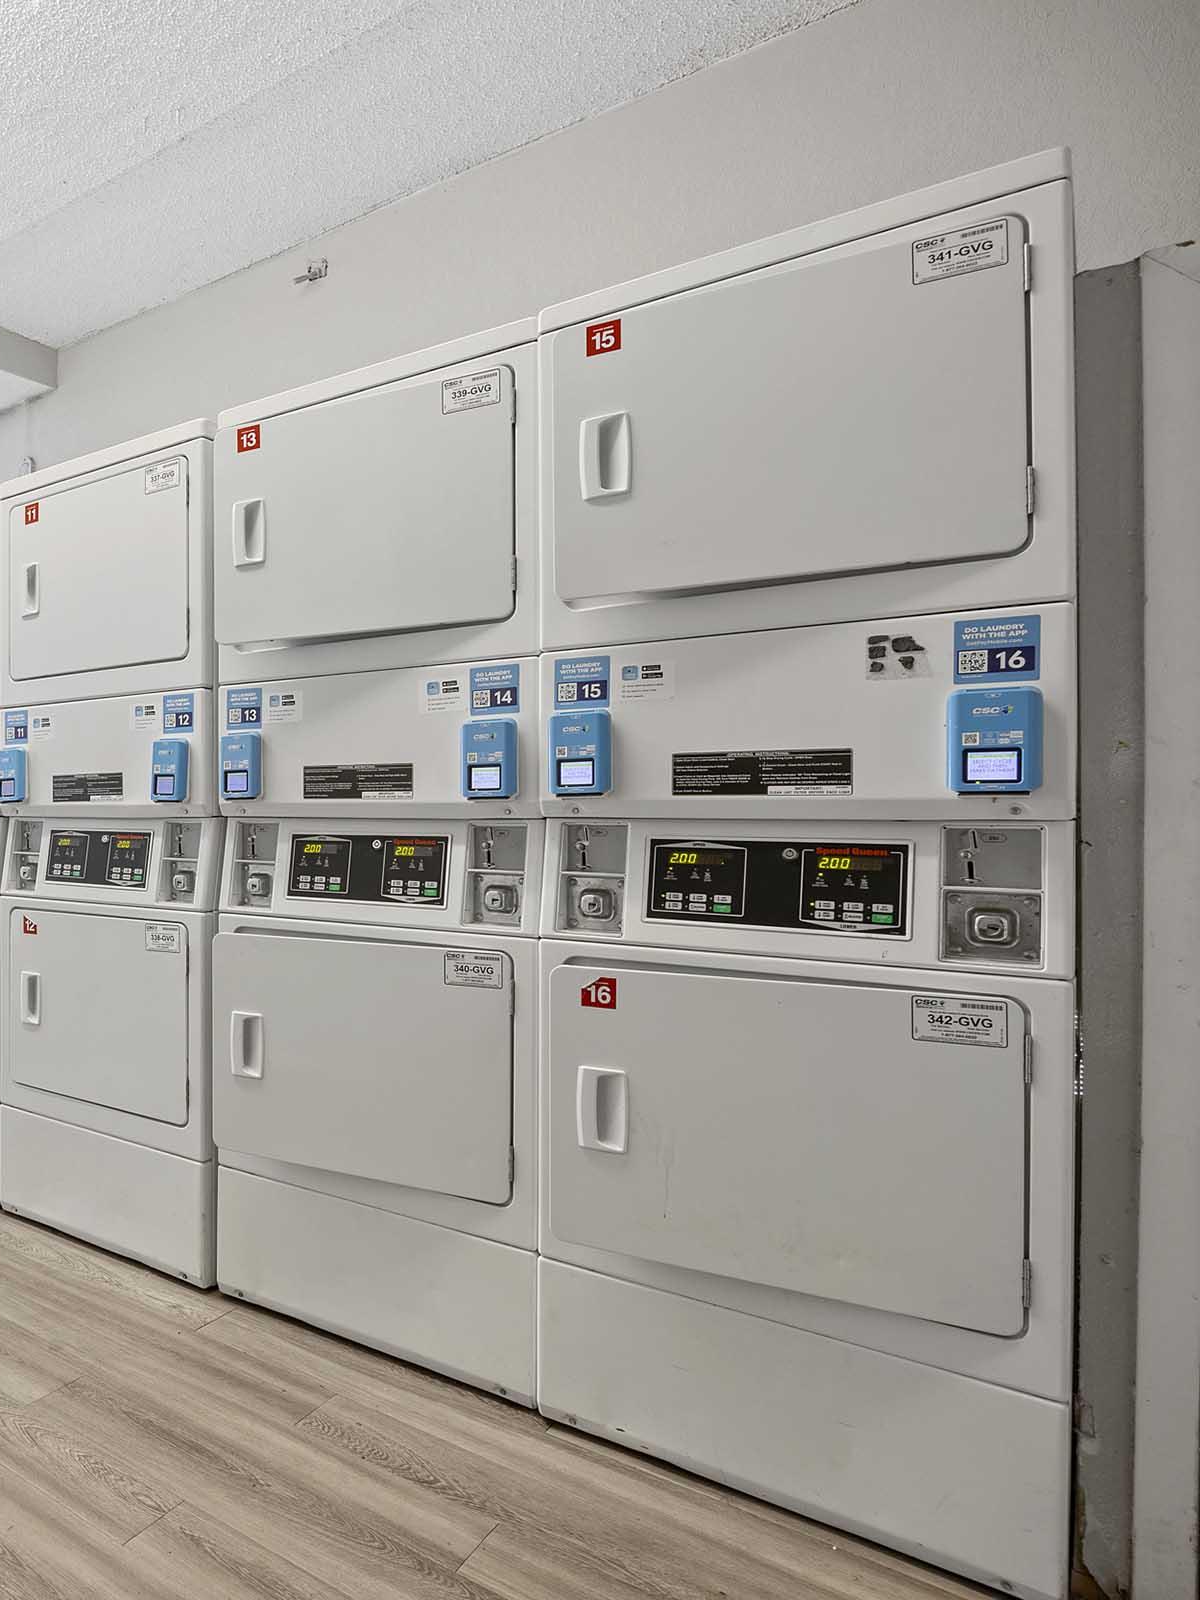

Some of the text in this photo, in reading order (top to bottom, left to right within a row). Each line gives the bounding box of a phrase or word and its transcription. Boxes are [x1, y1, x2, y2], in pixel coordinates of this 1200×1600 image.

[915, 239, 938, 250] CSC
[928, 240, 993, 264] 341-GVG
[591, 329, 615, 350] 15
[451, 384, 491, 399] 339-GVG
[240, 432, 256, 447] 13
[26, 509, 36, 521] 11
[962, 632, 986, 640] WITH
[1008, 629, 1028, 637] APP
[964, 623, 1025, 634] DO LAUNDRY
[995, 650, 1026, 669] 16
[582, 683, 601, 698] 15
[494, 690, 513, 704] 14
[244, 709, 257, 721] 13
[971, 706, 1000, 715] CSC
[178, 715, 189, 725] 12
[17, 728, 24, 738] 11
[816, 847, 889, 856] Speed Queen
[818, 857, 851, 869] 2.00
[25, 919, 36, 931] 12
[453, 964, 495, 975] 340-GVG
[586, 985, 611, 1004] 16
[915, 998, 938, 1006] CSC
[927, 1013, 993, 1029] 342-GVG
